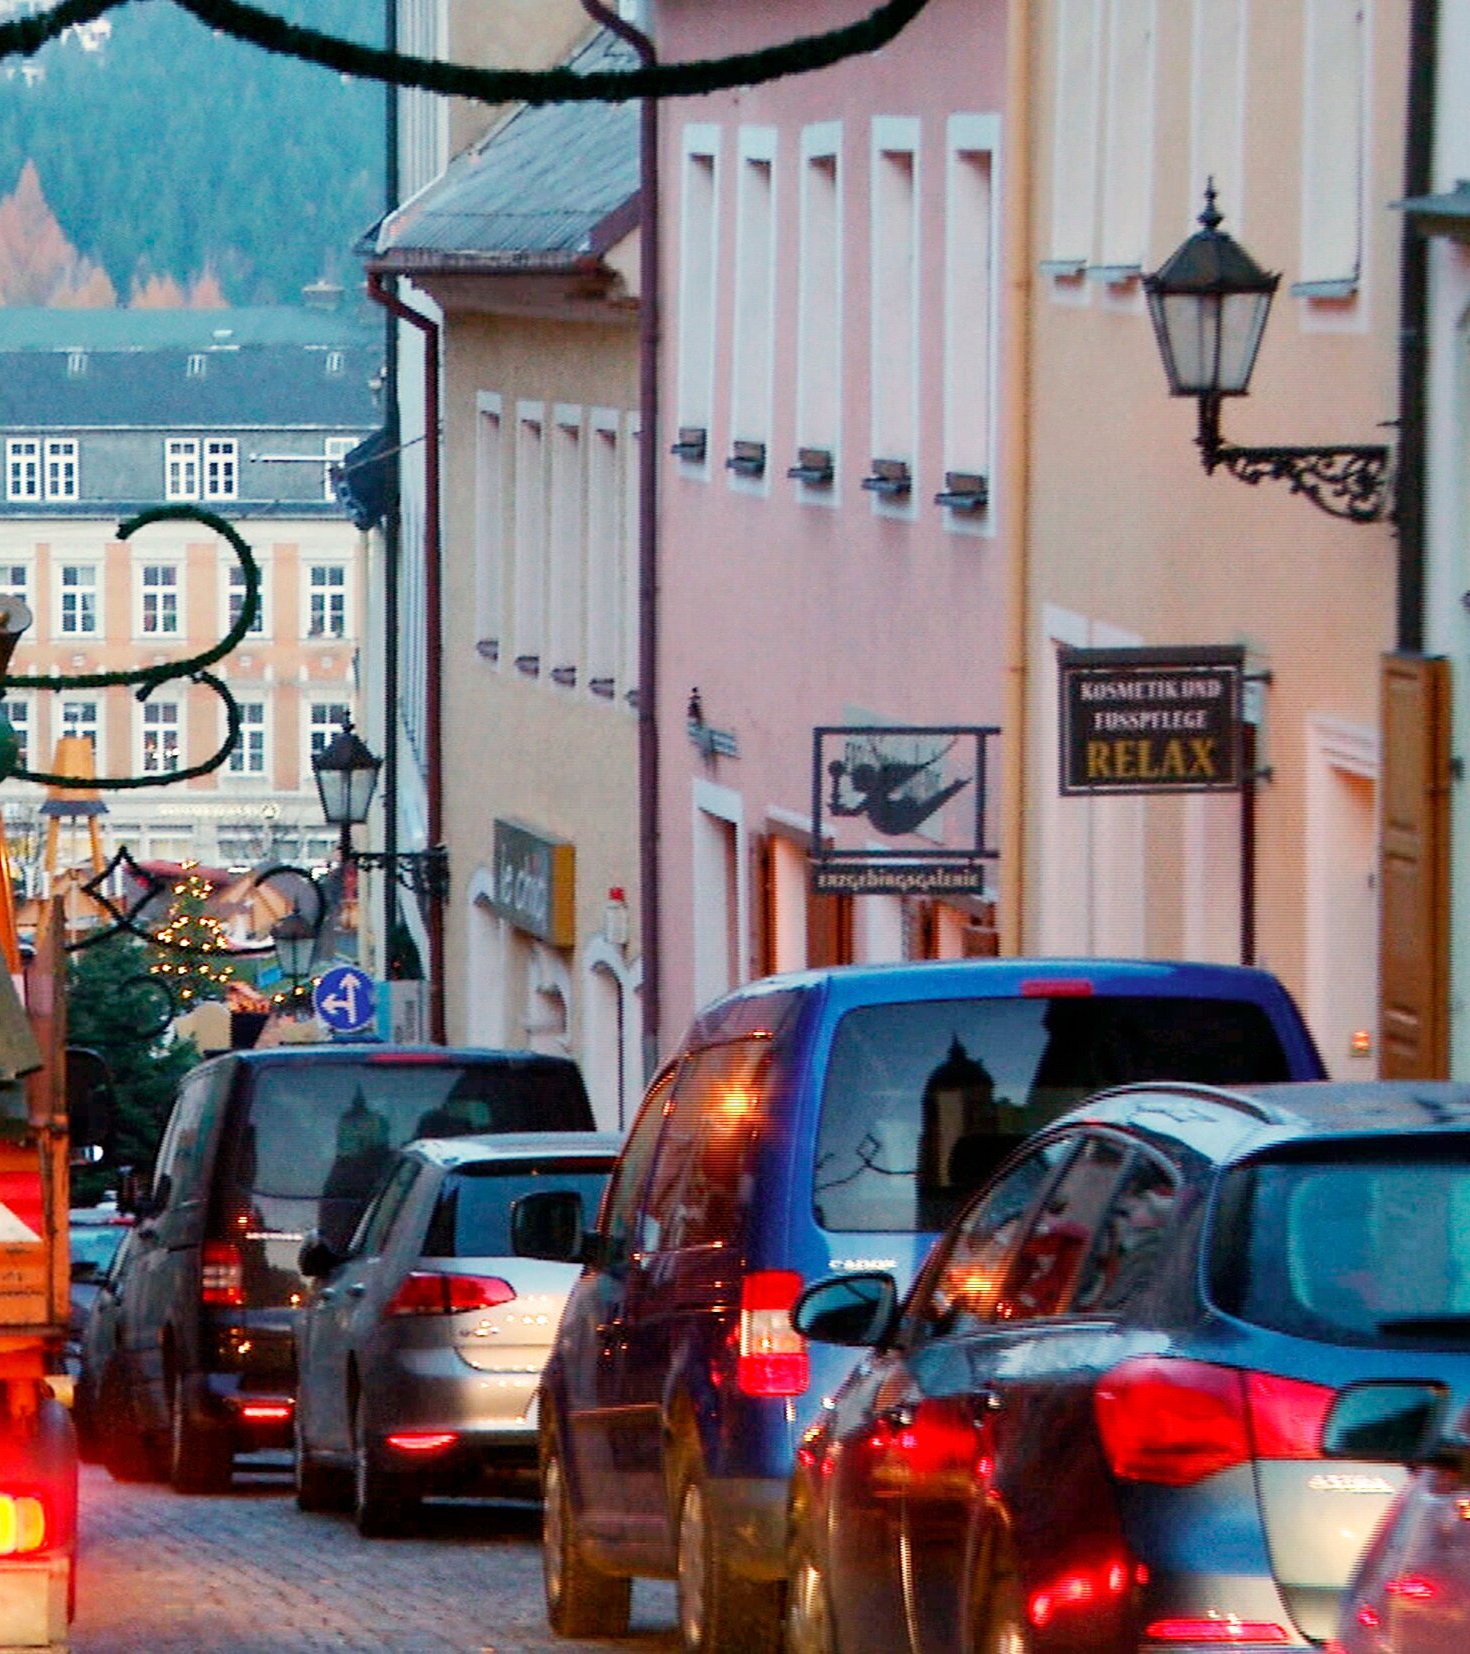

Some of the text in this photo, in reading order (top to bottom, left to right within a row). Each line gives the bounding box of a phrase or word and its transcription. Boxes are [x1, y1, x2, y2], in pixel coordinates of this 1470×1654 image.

[1081, 680, 1179, 701] KOSMETIK
[1093, 710, 1207, 731] FUSSPFLEGE
[1087, 738, 1216, 778] RELAX
